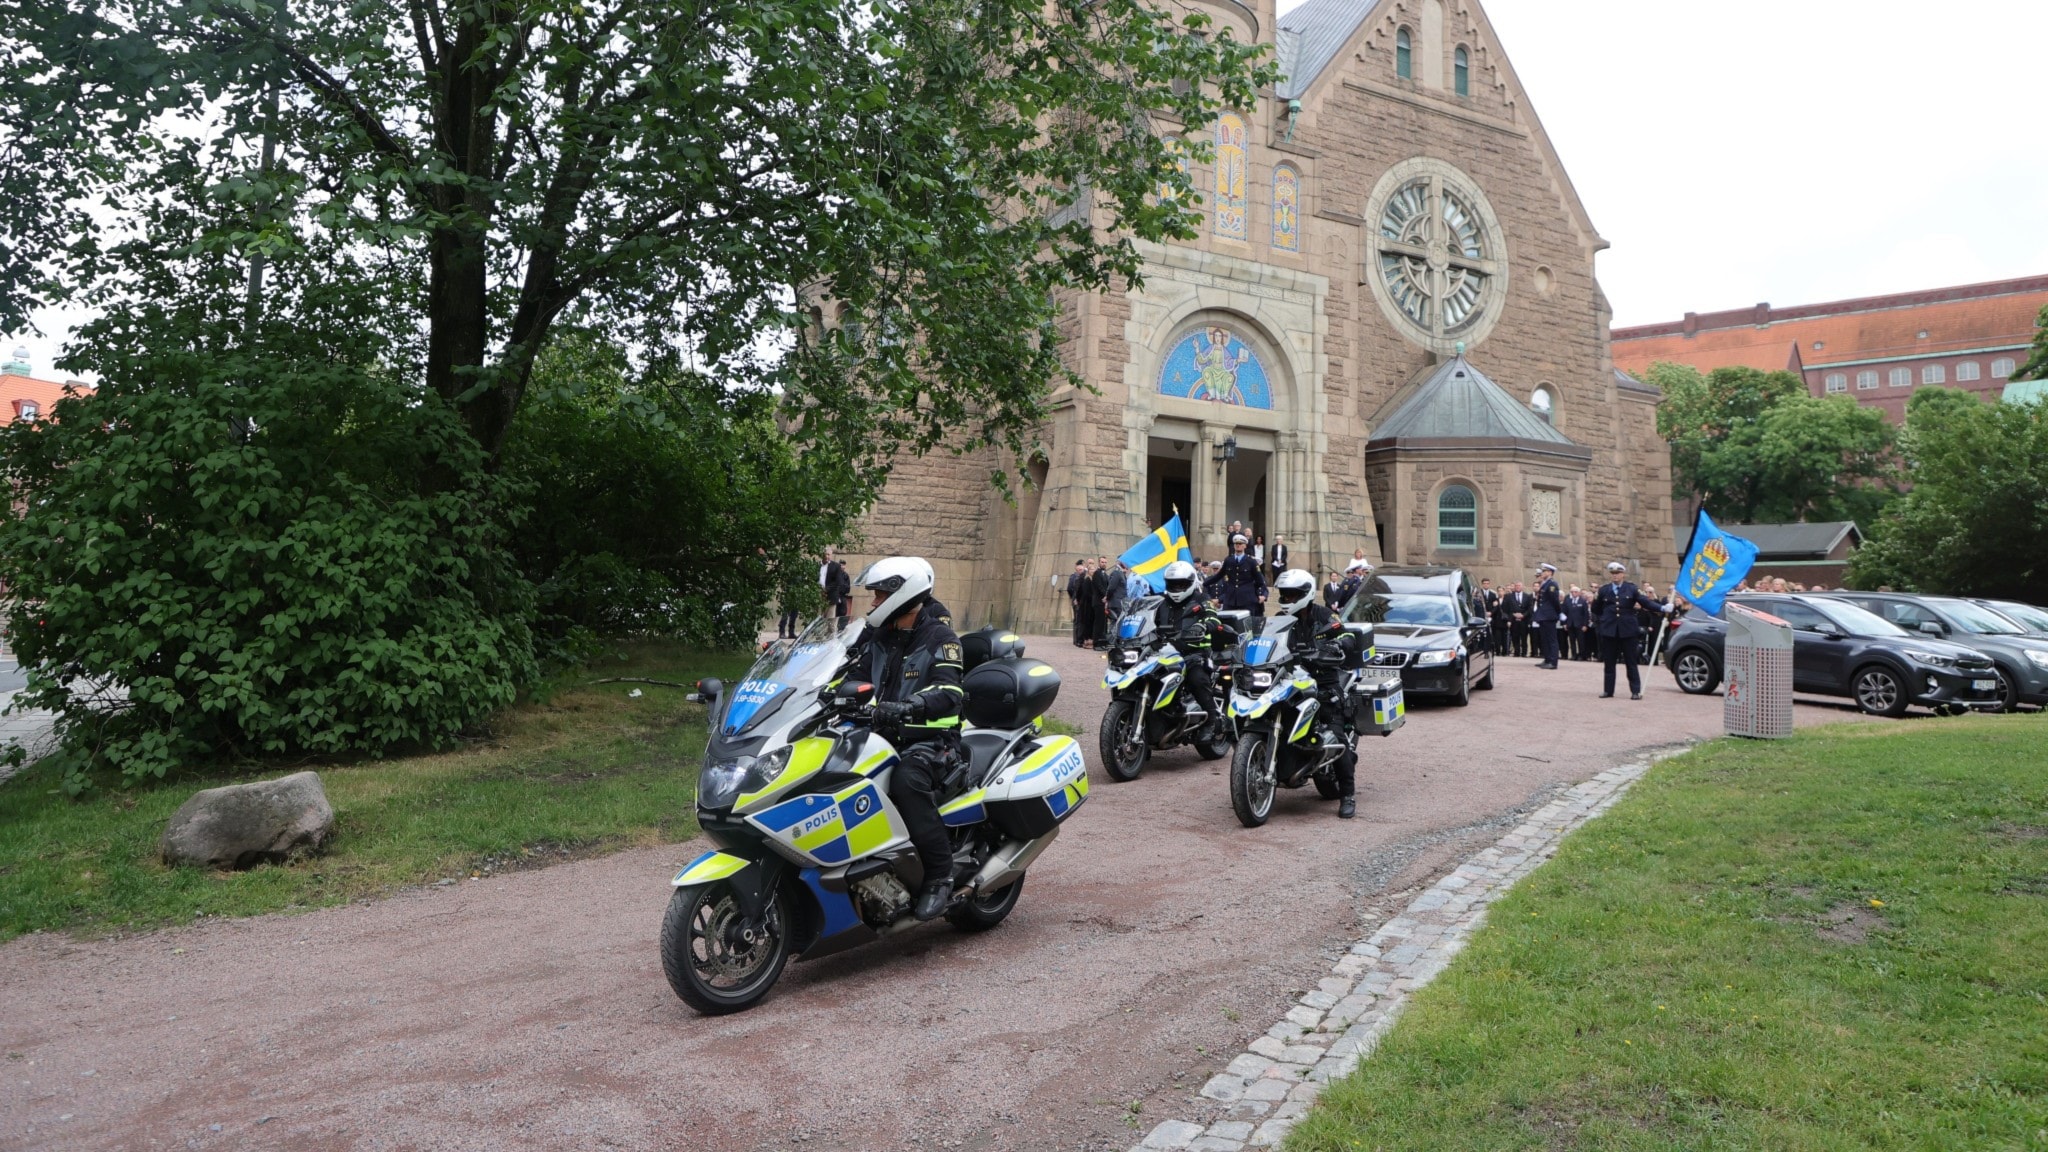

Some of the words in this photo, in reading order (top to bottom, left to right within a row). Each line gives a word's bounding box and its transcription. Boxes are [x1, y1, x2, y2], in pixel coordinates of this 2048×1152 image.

[1247, 639, 1272, 648] POLIS
[1361, 669, 1378, 678] DLE
[739, 680, 778, 695] POLIS
[1389, 691, 1402, 707] POLIS
[1052, 752, 1081, 782] POLIS
[805, 808, 838, 832] POLIS
